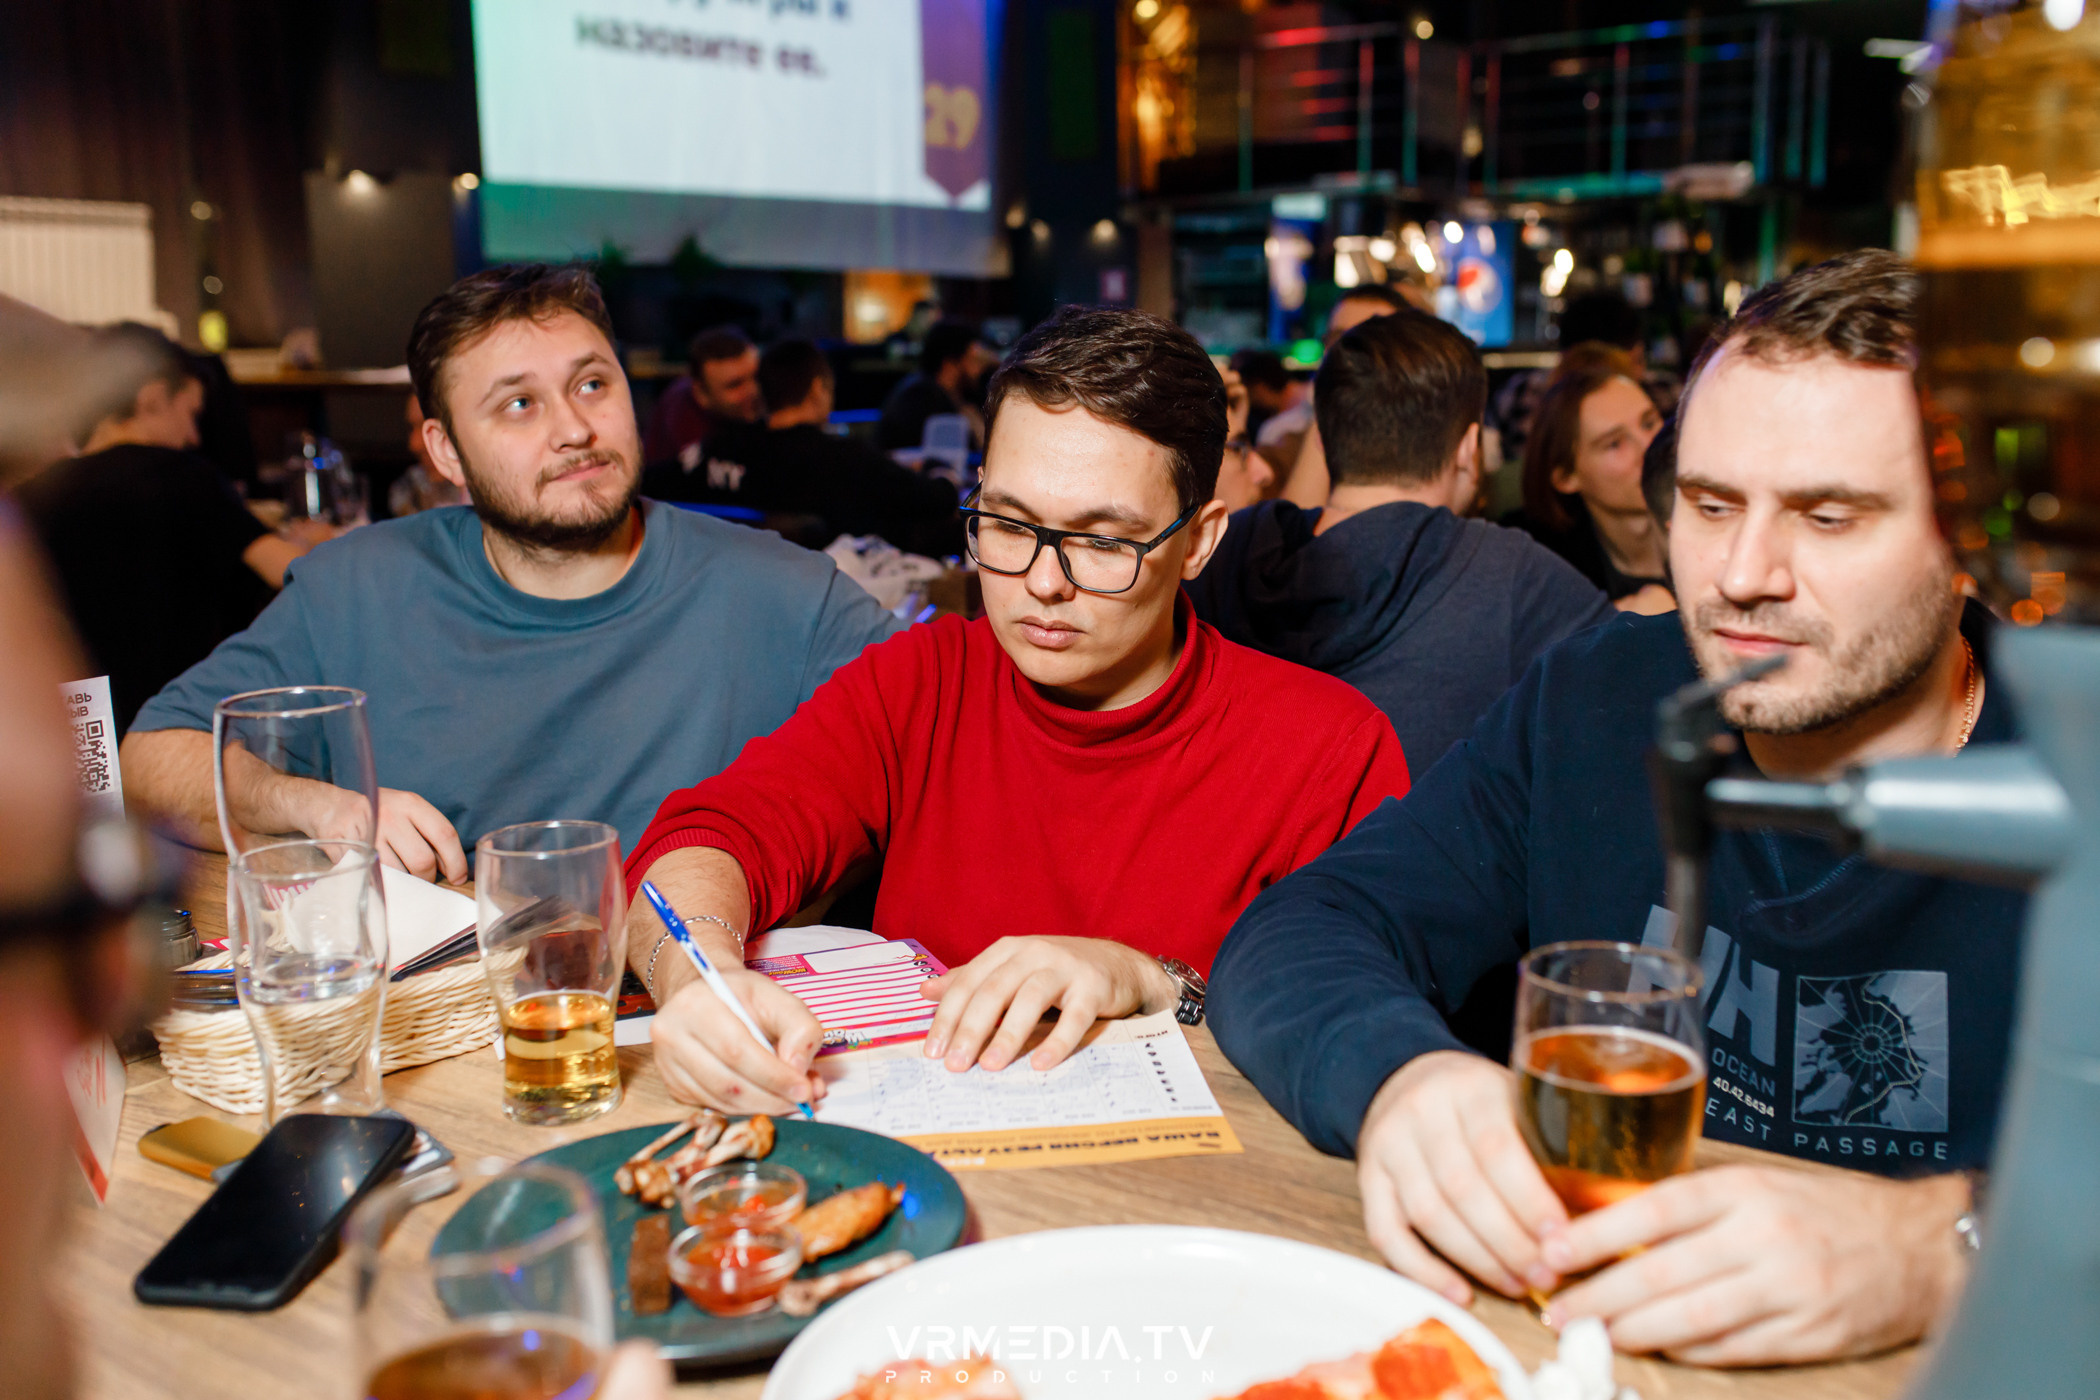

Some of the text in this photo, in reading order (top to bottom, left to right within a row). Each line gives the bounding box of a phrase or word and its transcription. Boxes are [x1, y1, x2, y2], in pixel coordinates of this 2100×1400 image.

[575, 16, 762, 68] назовите
[925, 84, 979, 149] 29
[65, 692, 92, 705] АВЬ
[1712, 1047, 1776, 1097] OCEAN
[1705, 1097, 1949, 1160] EAST PASSAGE
